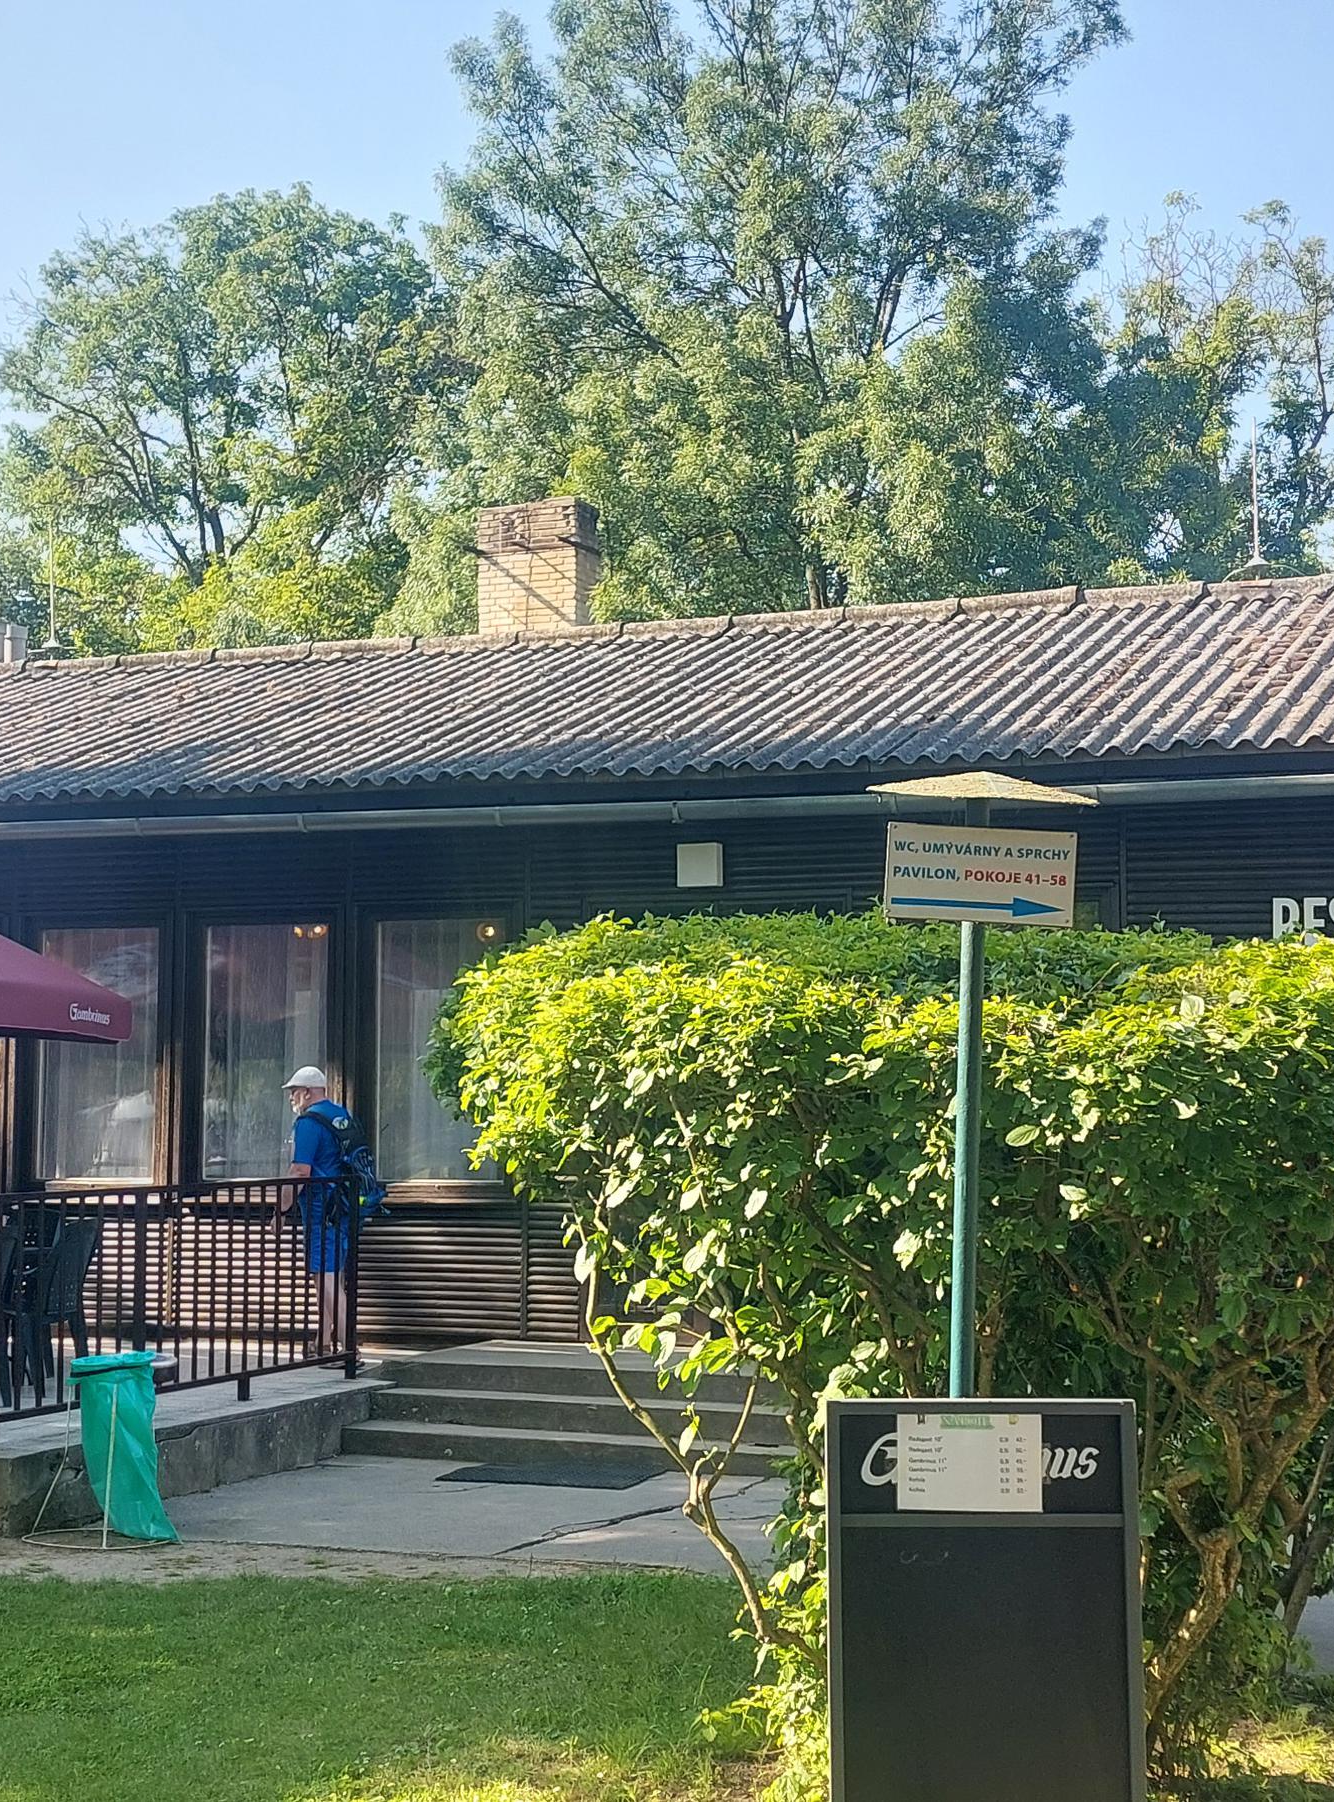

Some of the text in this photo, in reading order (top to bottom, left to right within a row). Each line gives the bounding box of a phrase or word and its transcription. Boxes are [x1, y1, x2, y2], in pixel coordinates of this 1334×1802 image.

[894, 840, 1071, 861] WC, UMÝVÁRNY A SPRCHY
[892, 865, 961, 882] PAVILON,
[964, 869, 1022, 885] POKOJE
[69, 1003, 111, 1025] Gambrinus
